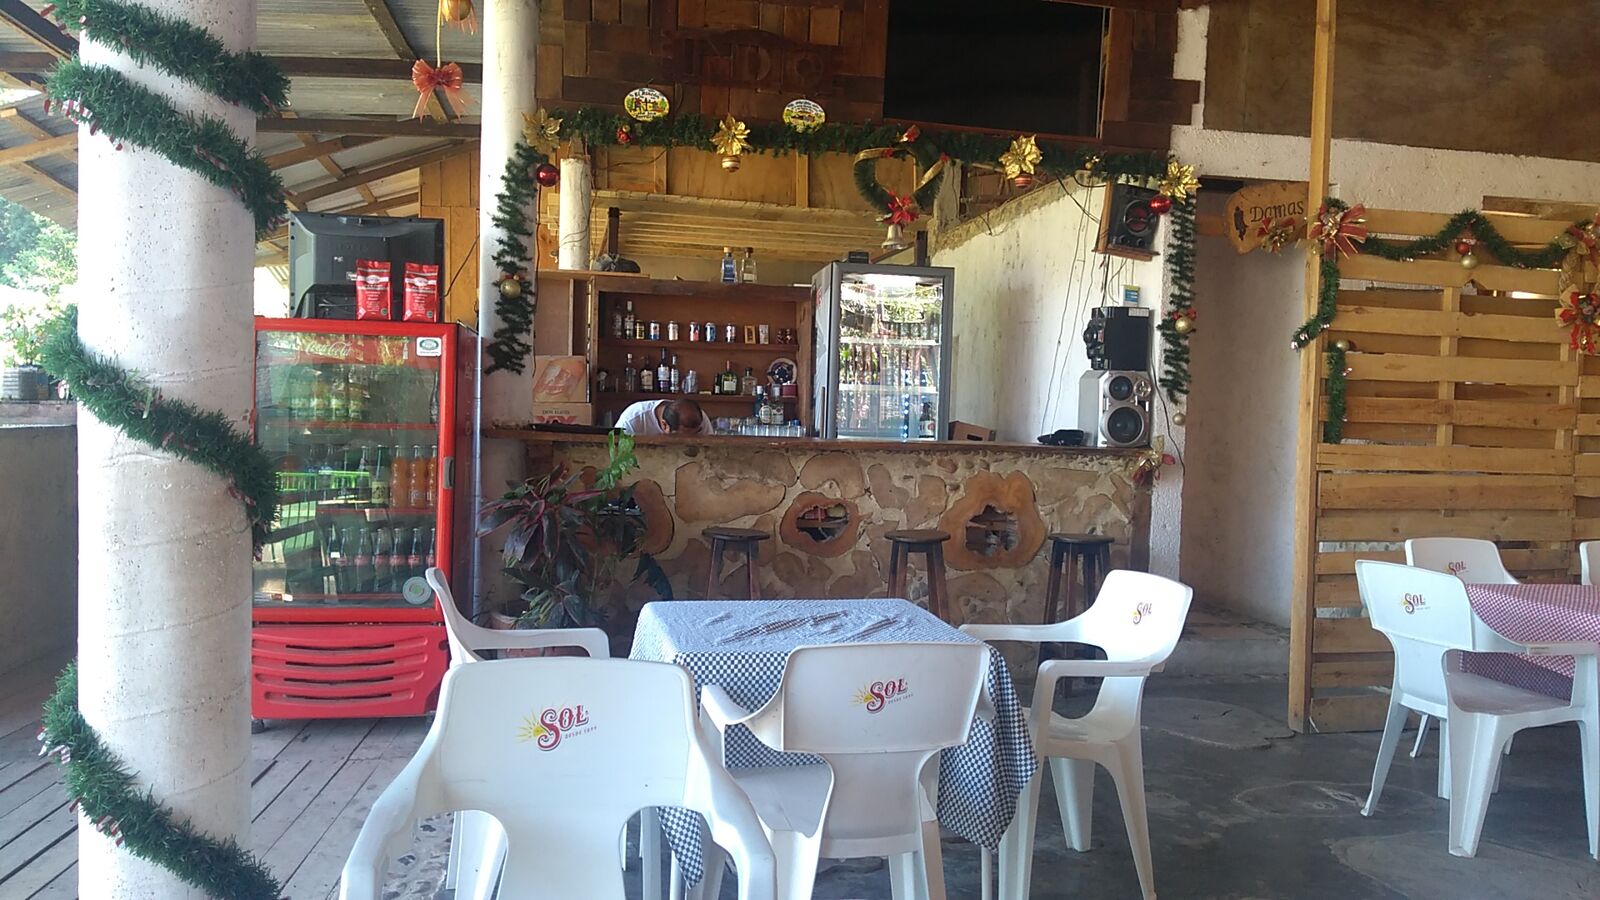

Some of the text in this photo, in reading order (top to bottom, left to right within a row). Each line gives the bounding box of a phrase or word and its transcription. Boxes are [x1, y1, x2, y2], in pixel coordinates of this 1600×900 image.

[1249, 200, 1304, 222] Damas
[1133, 602, 1152, 625] SOL
[1404, 593, 1426, 615] SOL
[867, 678, 908, 714] SOL
[538, 704, 589, 752] SOL
